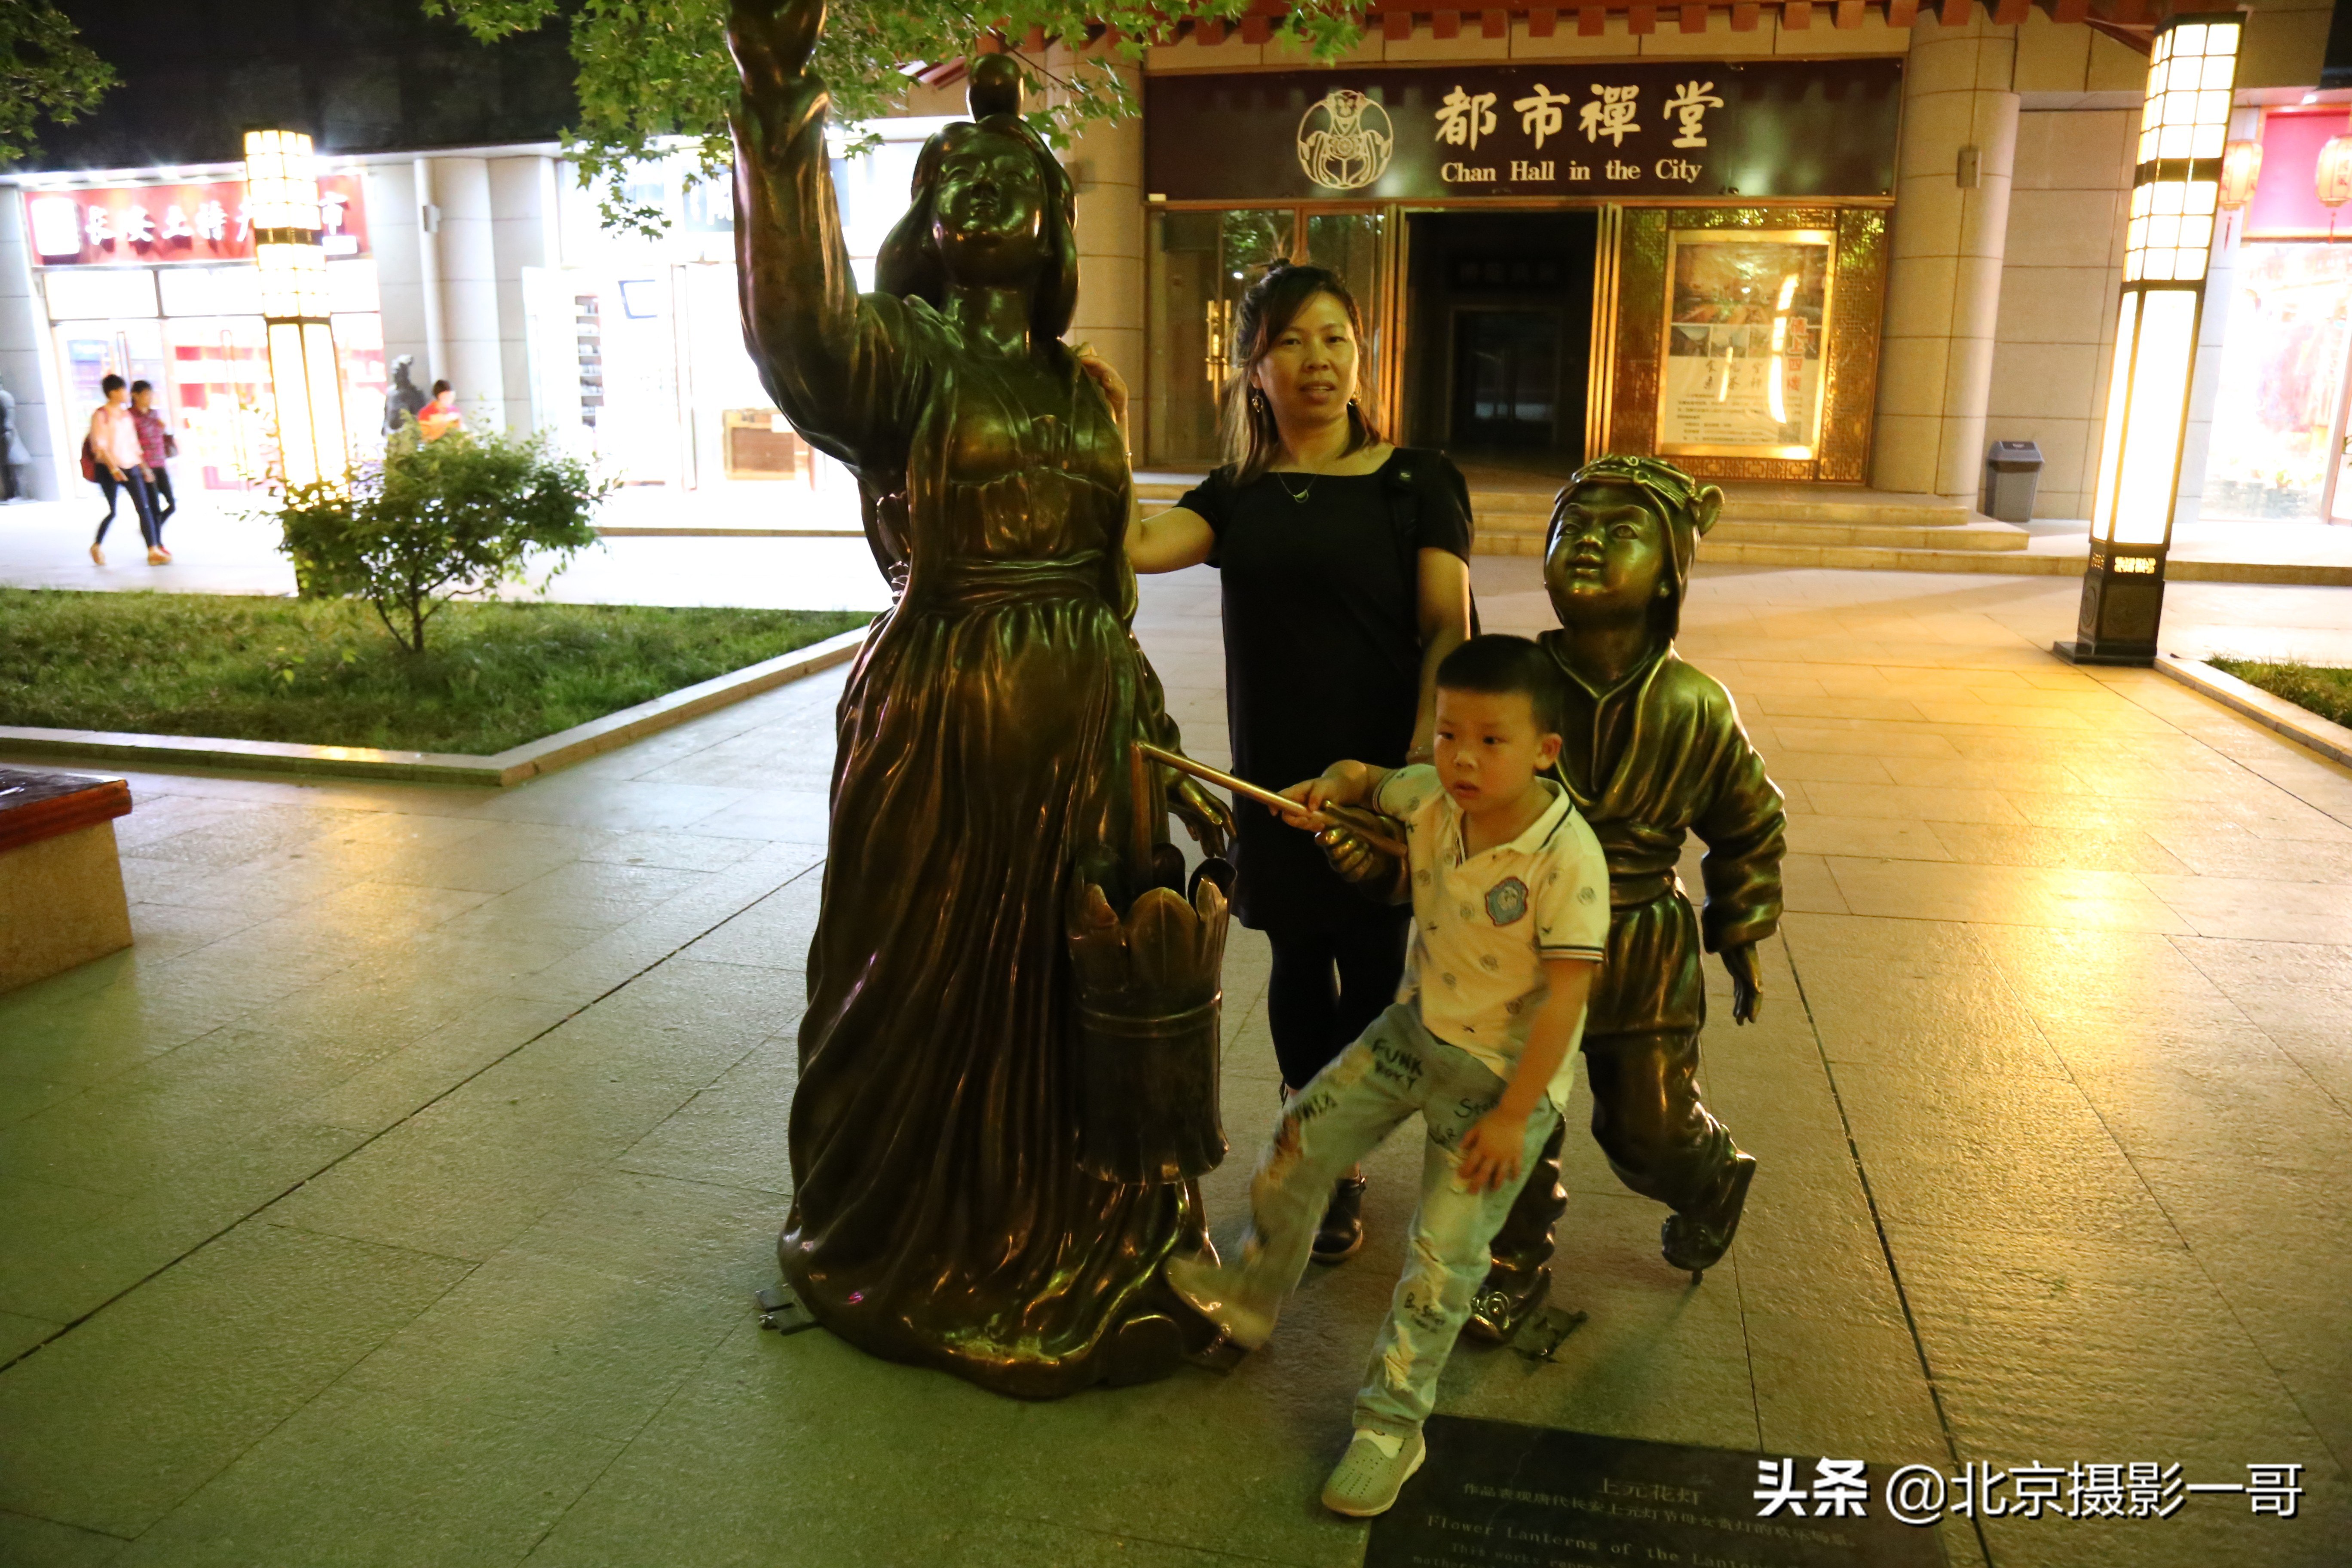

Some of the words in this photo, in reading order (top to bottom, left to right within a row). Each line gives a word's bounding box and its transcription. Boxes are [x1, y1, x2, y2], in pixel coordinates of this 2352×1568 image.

[1435, 80, 1724, 150] 都市禪堂
[1441, 162, 1496, 182] Chan
[1510, 160, 1555, 181] Hall
[1569, 160, 1590, 180] in
[1605, 160, 1641, 180] the
[1655, 159, 1702, 184] City
[1428, 1515, 1494, 1536] Flower
[1507, 1527, 1598, 1551] Lanterns
[1611, 1543, 1632, 1556] of
[1648, 1548, 1679, 1562] the
